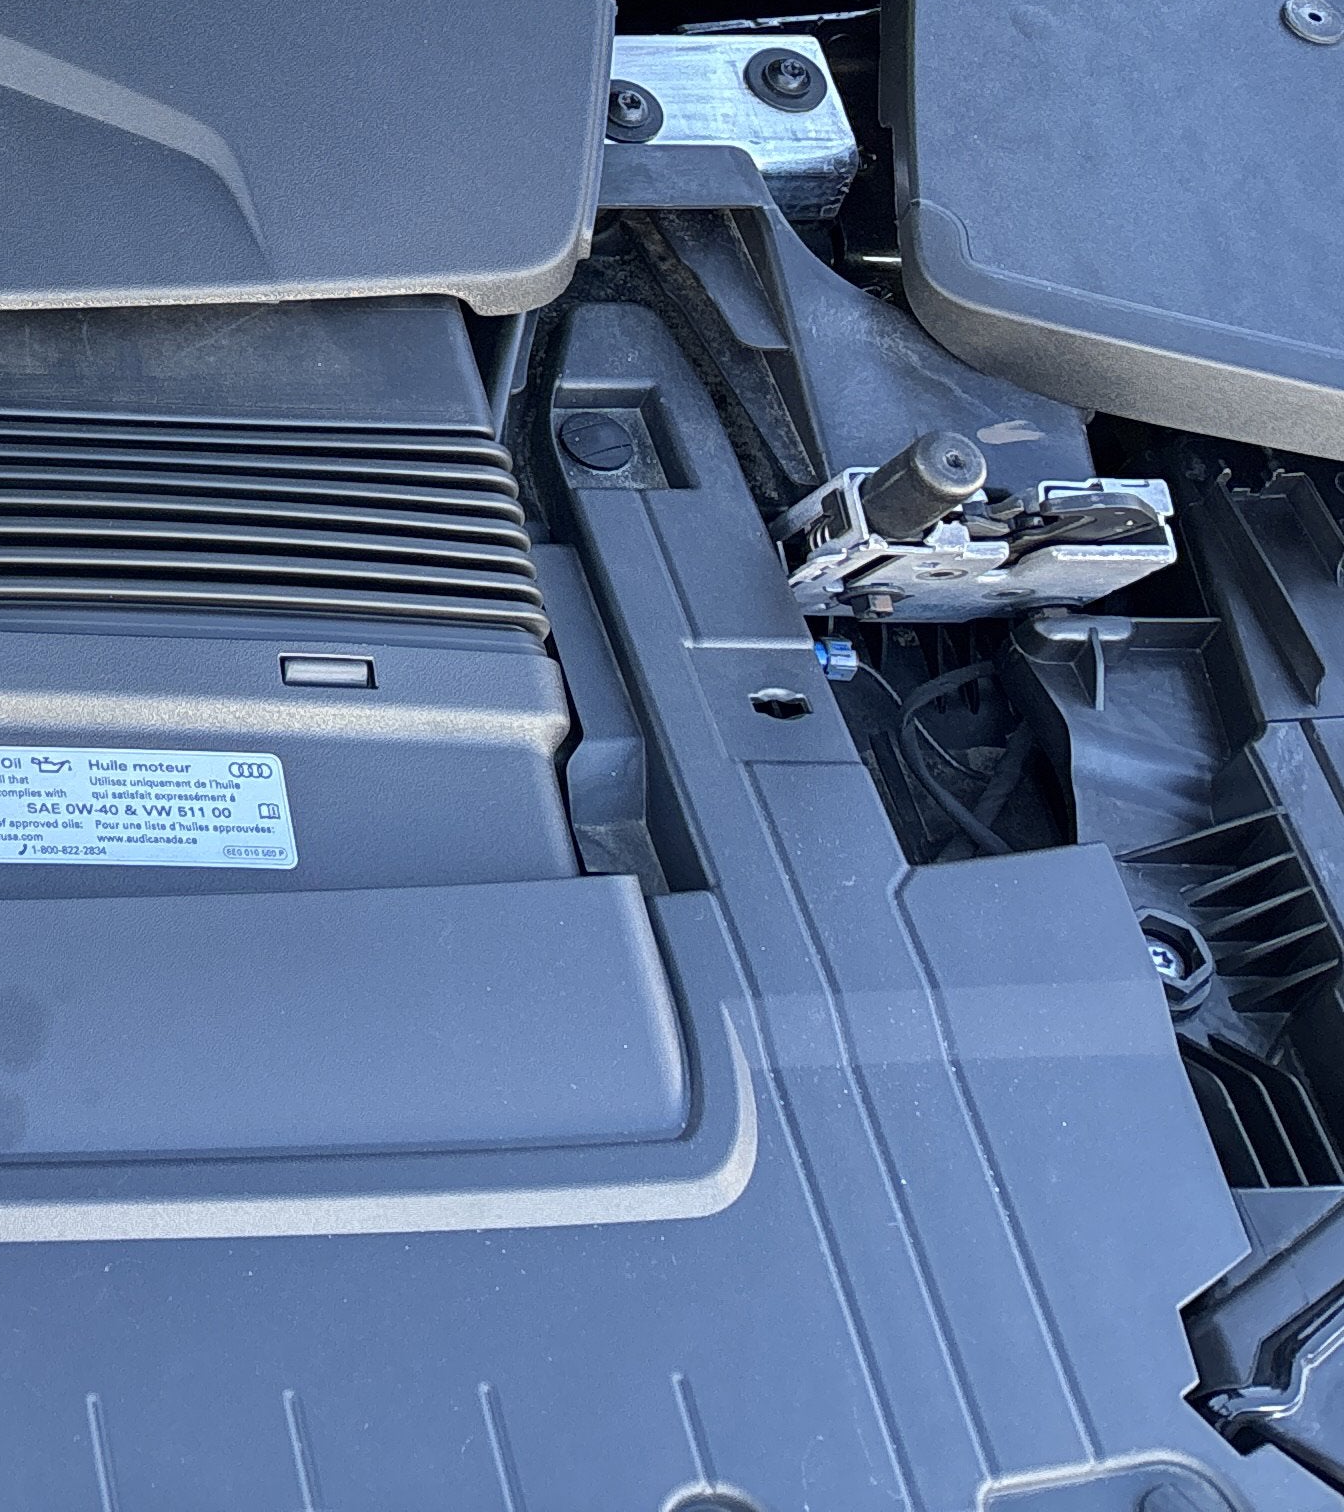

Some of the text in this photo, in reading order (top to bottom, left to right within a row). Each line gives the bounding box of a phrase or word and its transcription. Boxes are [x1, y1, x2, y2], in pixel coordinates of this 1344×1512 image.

[0, 757, 22, 770] Oil
[88, 759, 192, 773] Huile moteur
[7, 775, 30, 785] that
[89, 776, 127, 787] Utilisez
[129, 778, 192, 788] uniquement
[194, 779, 207, 789] de
[44, 788, 67, 798] with
[91, 790, 109, 801] qui
[111, 790, 152, 800] satisfait
[154, 792, 228, 803] expressément
[27, 802, 232, 819] SAE 0W-40 & VW 511 00
[9, 818, 59, 830] approved
[61, 819, 84, 829] oils:
[95, 819, 120, 830] Pour
[123, 822, 142, 830] une
[144, 821, 167, 831] liste
[212, 823, 276, 835] approuvées:
[96, 834, 198, 845] www.audicanada.ca
[31, 845, 107, 855] 1-800-822-2834
